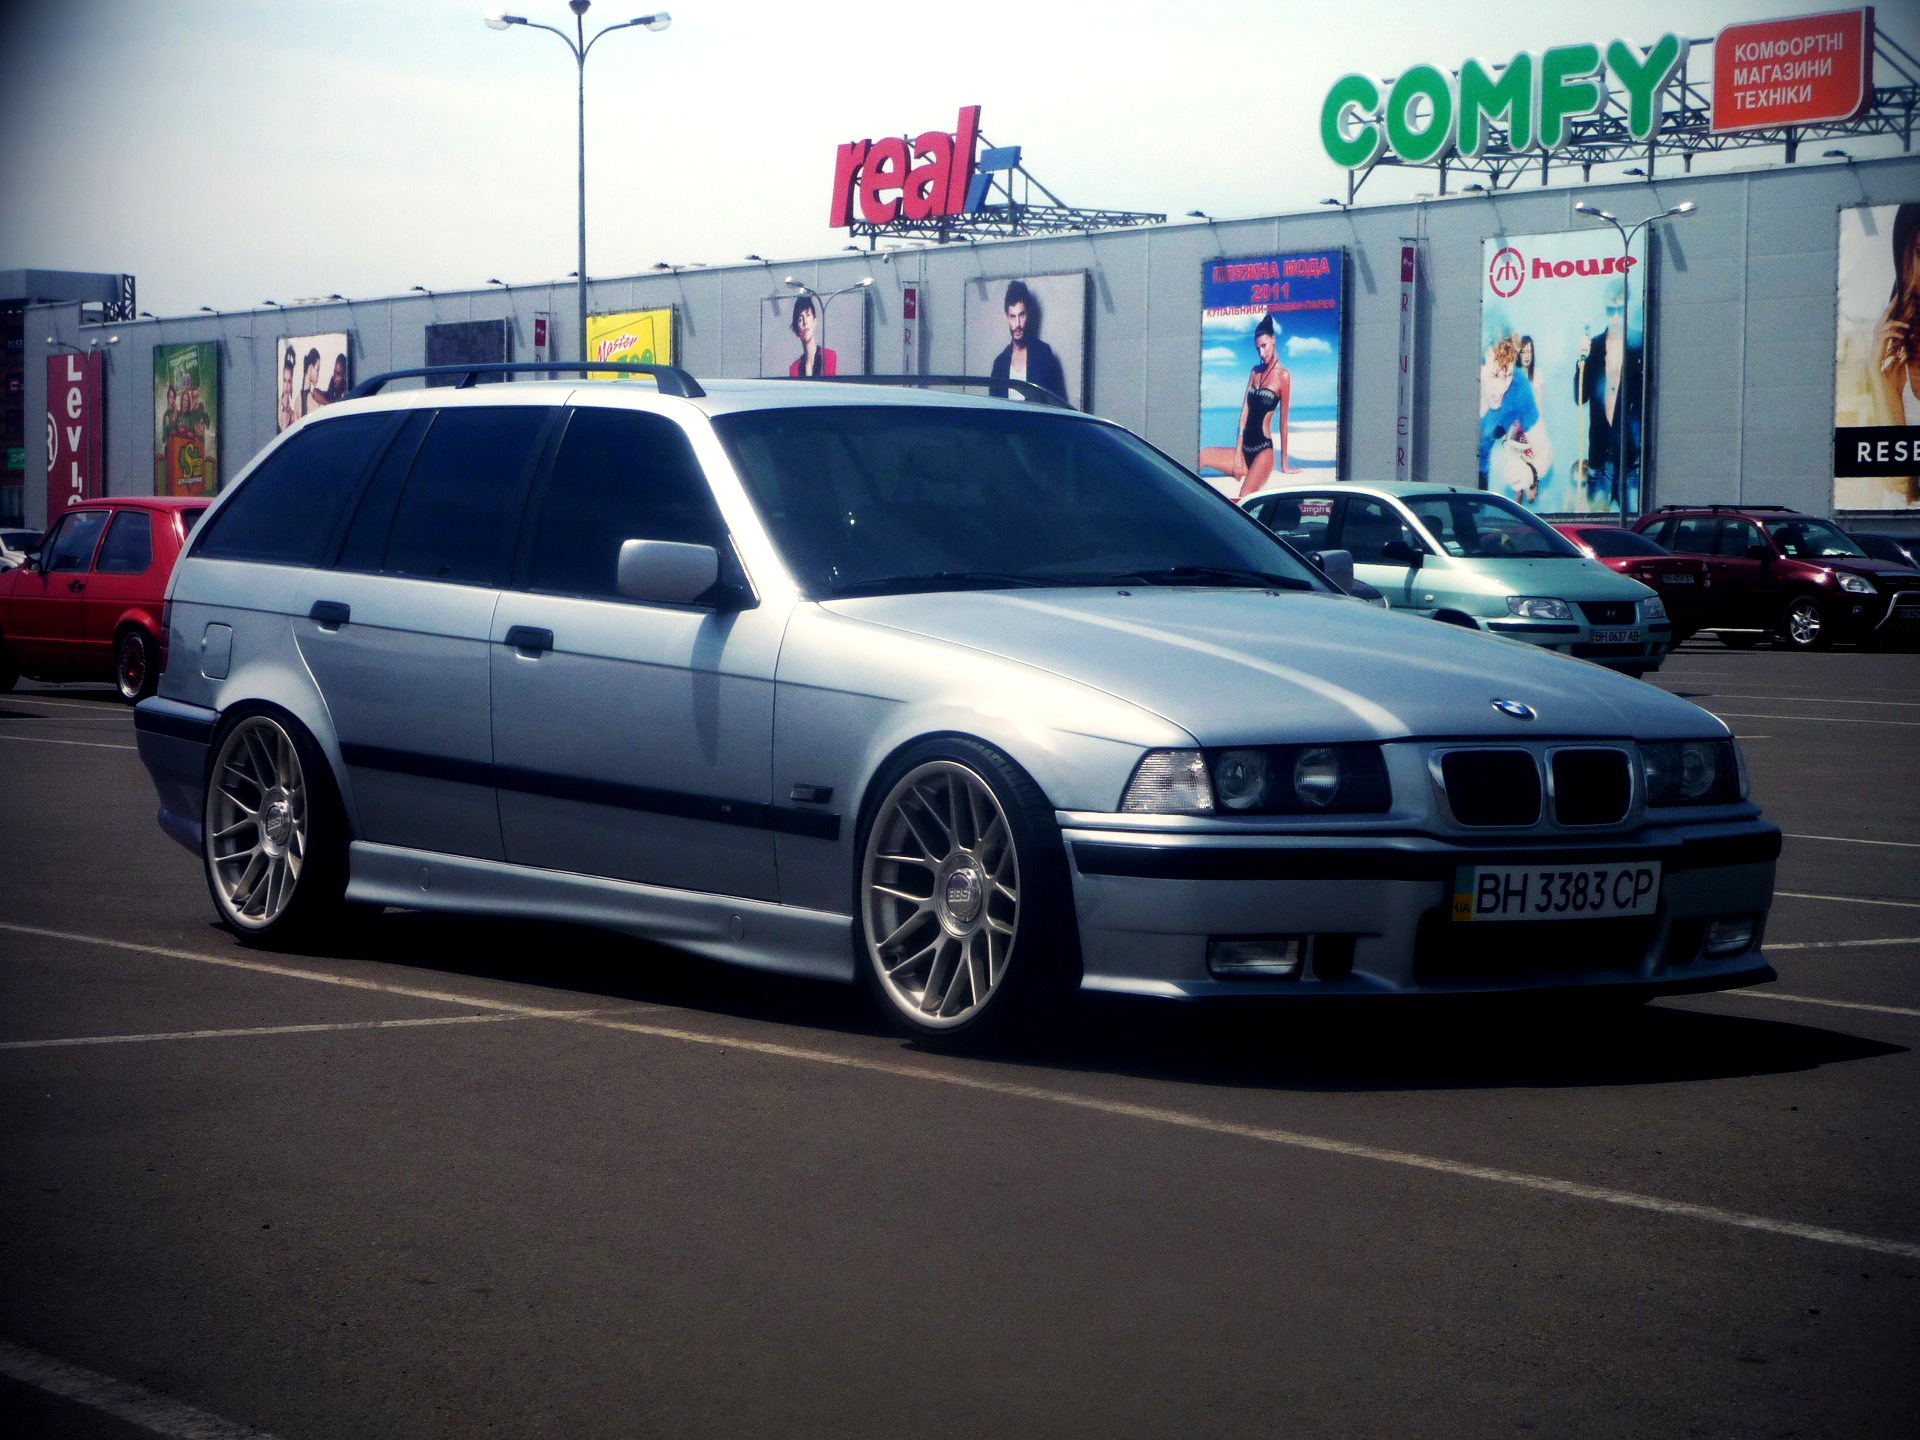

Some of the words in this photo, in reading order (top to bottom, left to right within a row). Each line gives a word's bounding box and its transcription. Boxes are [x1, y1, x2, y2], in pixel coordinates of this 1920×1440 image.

[1735, 32, 1844, 62] КОМФОРТНІ
[1734, 58, 1832, 86] МАГАЗИНИ
[1320, 32, 1688, 169] COMFY
[1734, 84, 1812, 110] ТЕХНІКИ
[1283, 257, 1330, 278] МОДА
[1531, 255, 1637, 280] house
[1251, 282, 1290, 302] 2011
[1397, 293, 1408, 482] RIVIER
[1476, 873, 1529, 913] BH
[1535, 871, 1608, 912] 3383
[1613, 869, 1653, 909] CP
[1455, 902, 1470, 913] UA
